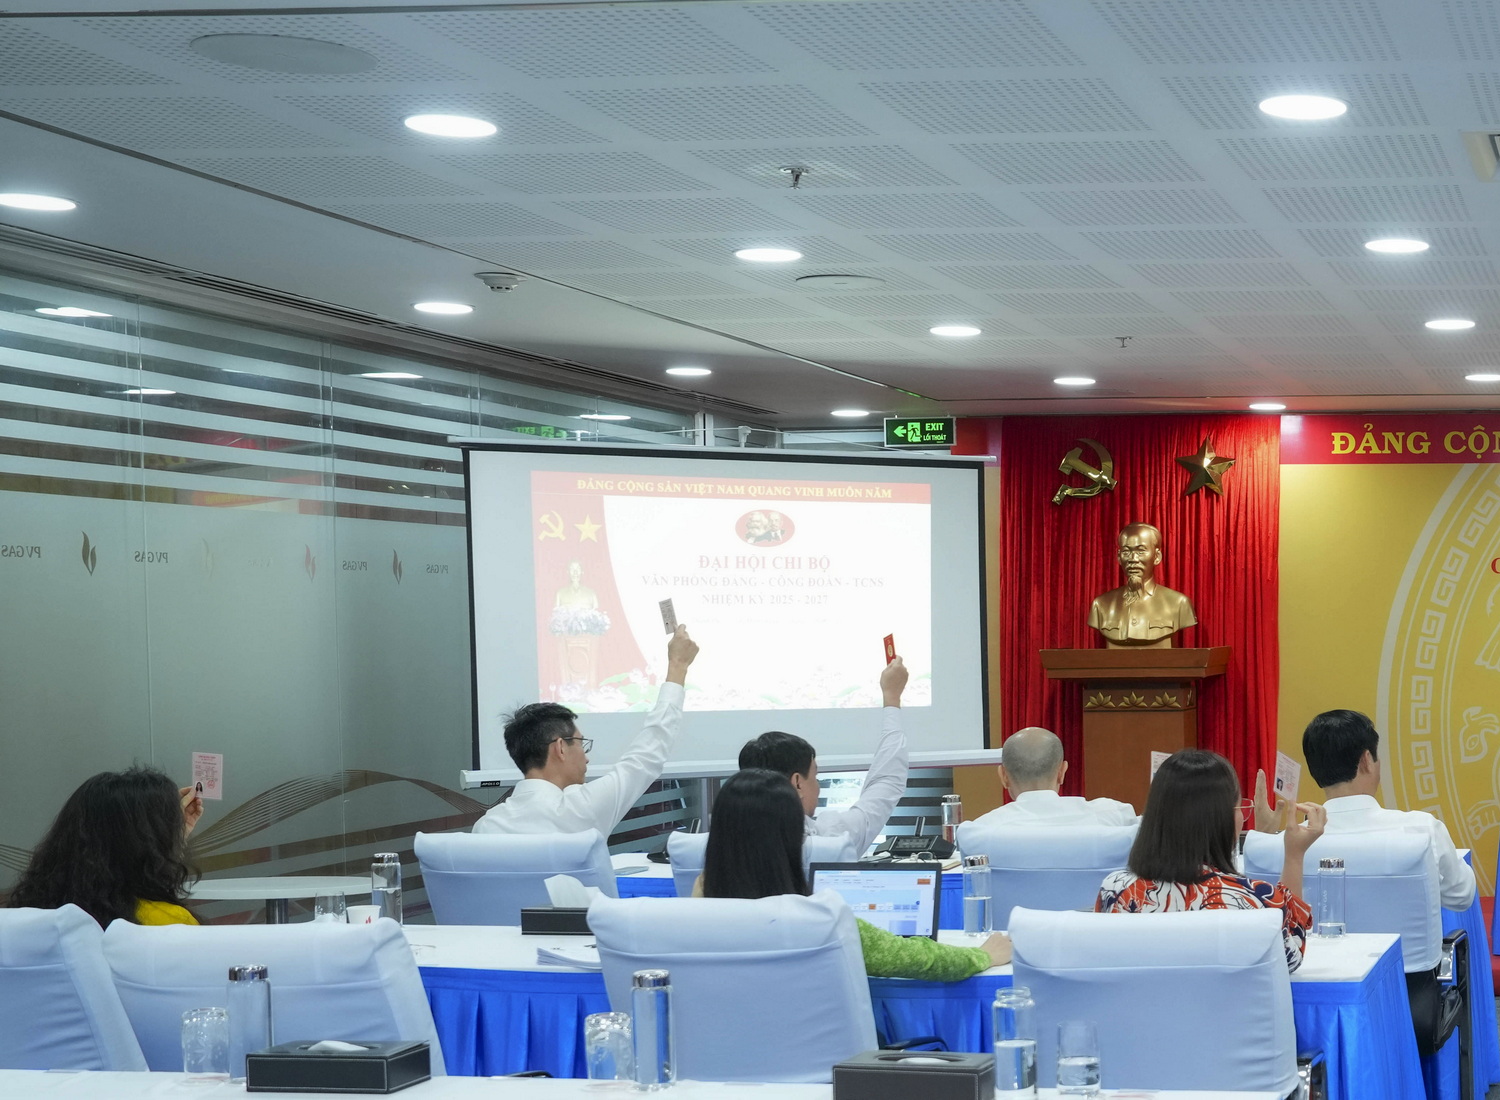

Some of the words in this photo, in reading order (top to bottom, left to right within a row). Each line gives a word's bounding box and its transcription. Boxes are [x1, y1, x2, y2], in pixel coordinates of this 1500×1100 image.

[925, 423, 944, 431] EXIT
[923, 433, 931, 441] LỐI
[932, 433, 946, 441] THOÁT
[1331, 423, 1431, 454] ĐẢNG
[577, 478, 614, 490] ĐẢNG
[617, 480, 654, 493] CỘNG
[657, 481, 681, 493] SẢN
[685, 483, 714, 495] VIỆT
[717, 484, 745, 495] NAM
[748, 485, 791, 496] QUANG
[794, 487, 824, 497] VINH
[827, 486, 862, 498] MUÔN
[865, 487, 892, 498] NĂM
[698, 555, 729, 572] ĐẠI
[736, 554, 766, 573] HỘI
[772, 556, 802, 569] CHI
[808, 555, 830, 573] BỘ
[854, 577, 884, 587] TCNS
[770, 594, 794, 605] 2025
[804, 594, 828, 605] 2027
